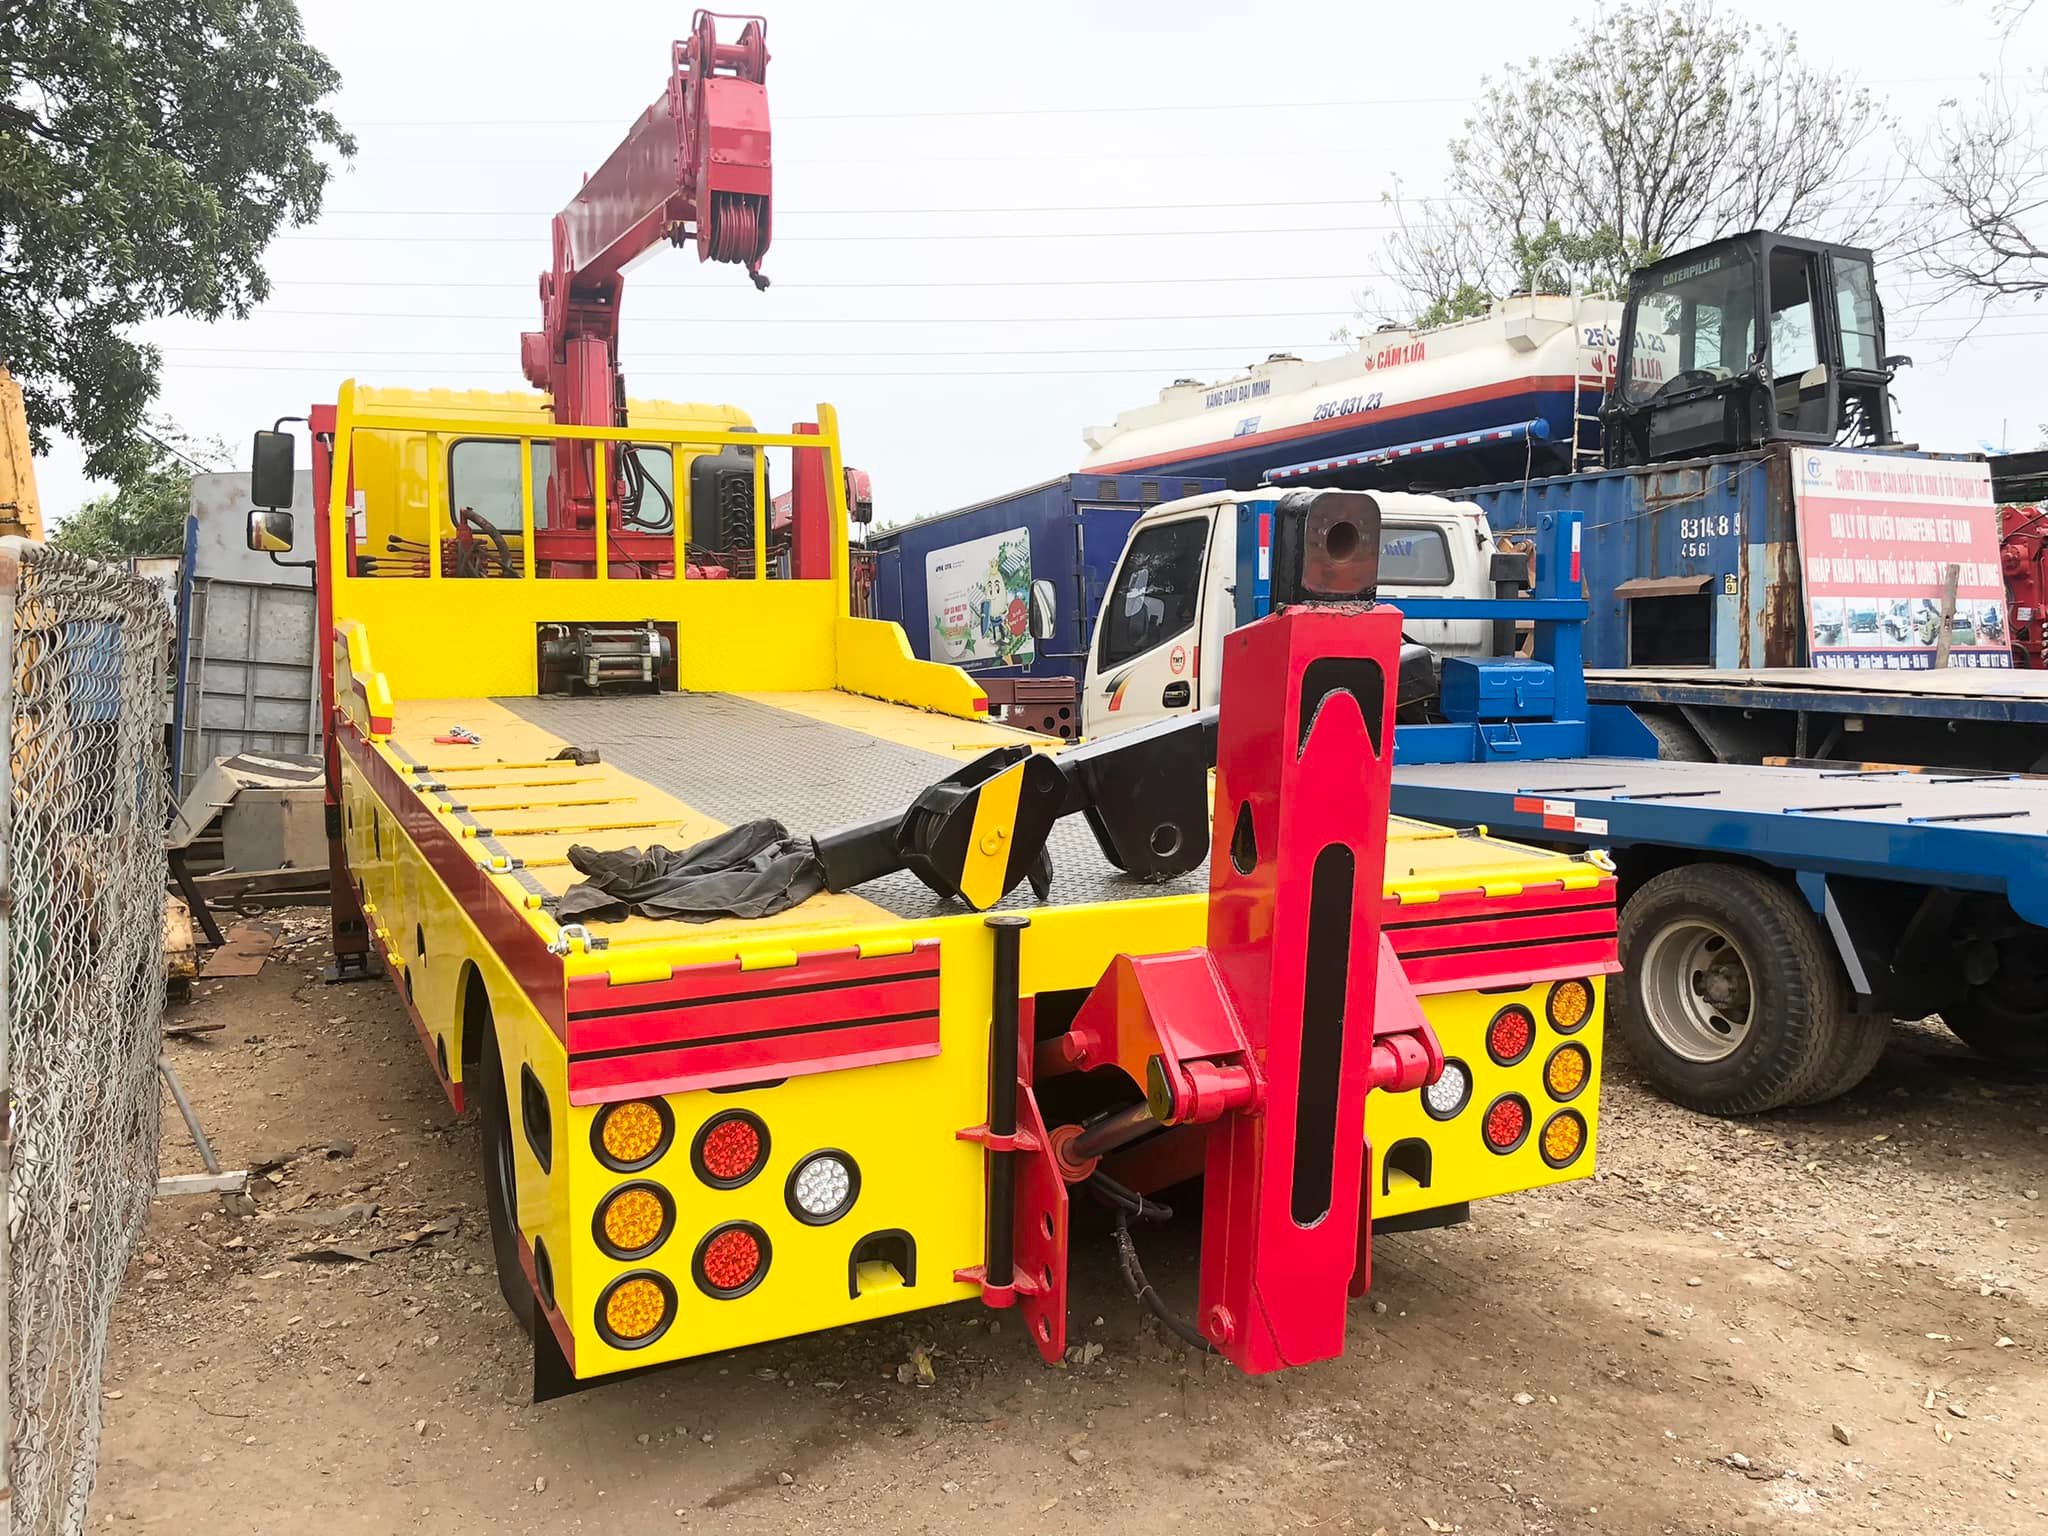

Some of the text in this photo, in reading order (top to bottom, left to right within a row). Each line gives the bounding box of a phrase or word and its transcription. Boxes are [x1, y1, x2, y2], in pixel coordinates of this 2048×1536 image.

[1662, 257, 1721, 286] CATERPILLAR
[1252, 380, 1271, 398] MINH
[1312, 392, 1383, 421] 25C-031.23
[1952, 520, 1972, 544] NAM
